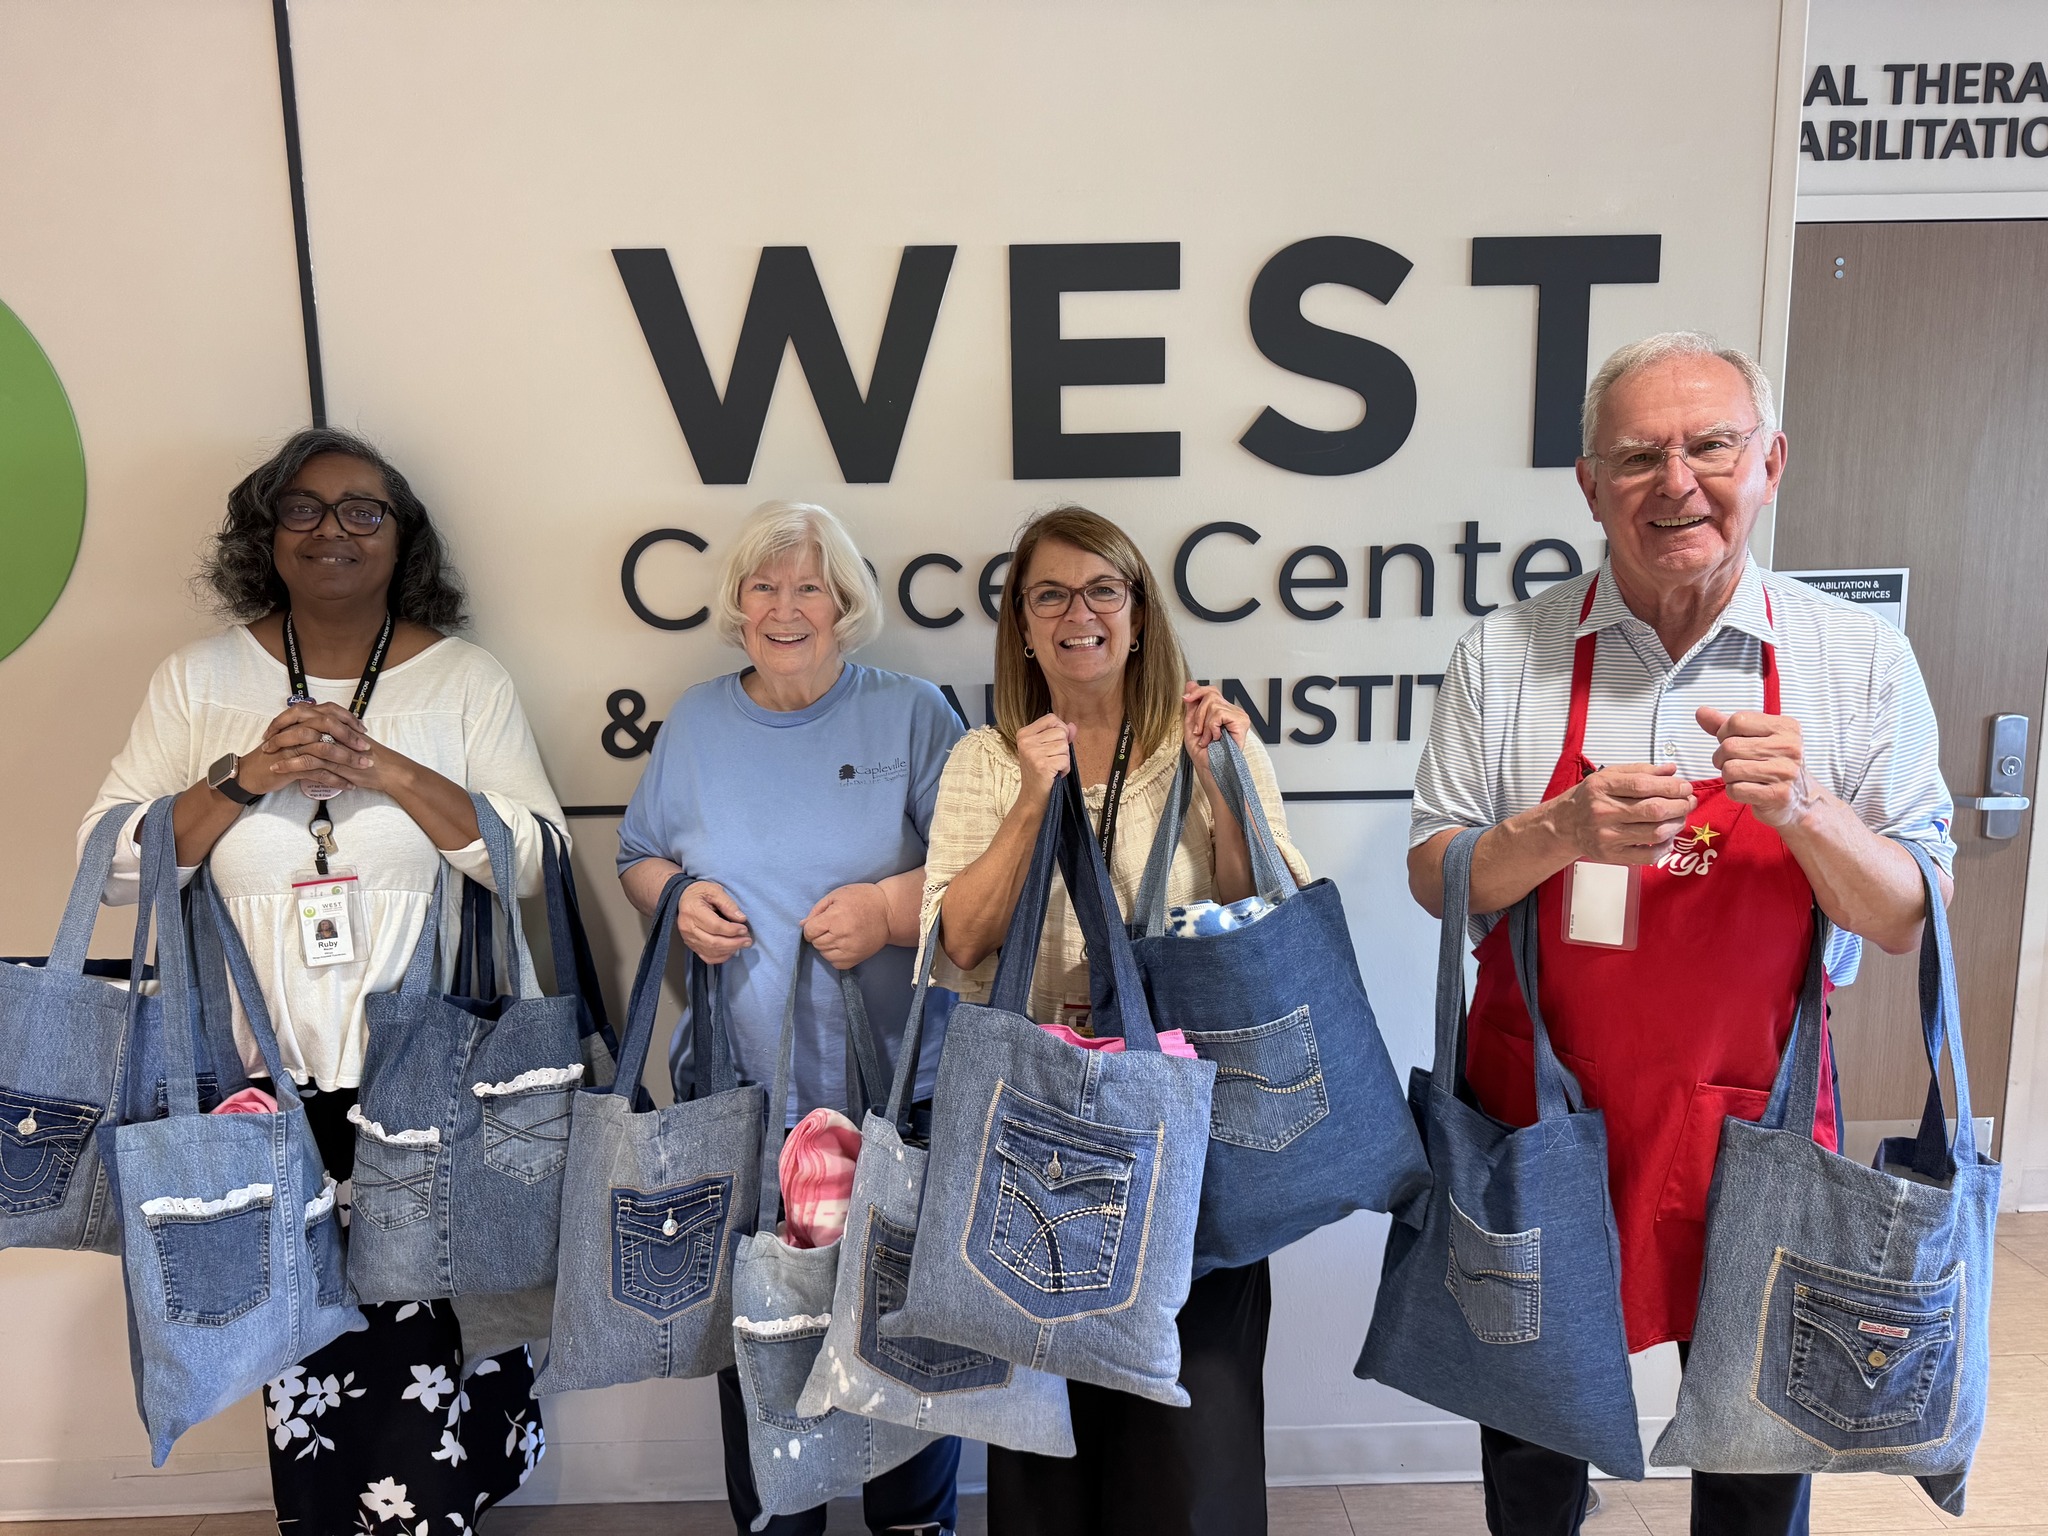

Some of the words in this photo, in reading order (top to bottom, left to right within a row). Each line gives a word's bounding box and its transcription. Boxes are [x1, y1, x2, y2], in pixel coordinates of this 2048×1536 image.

[1803, 65, 1868, 106] AL
[1883, 62, 2048, 105] THERA
[1800, 117, 2048, 161] ABILITATIO
[611, 234, 1662, 485] WEST
[1173, 520, 1610, 623] Cente
[1851, 590, 1891, 599] SERVICES
[601, 688, 665, 760] &
[1120, 735, 1129, 754] CLINICAL
[855, 757, 907, 780] Capleville
[1107, 801, 1115, 818] KNOW
[1112, 770, 1121, 789] OPTIONS
[1650, 848, 1718, 877] ngs
[321, 901, 342, 909] WEST
[317, 940, 338, 949] Ruby
